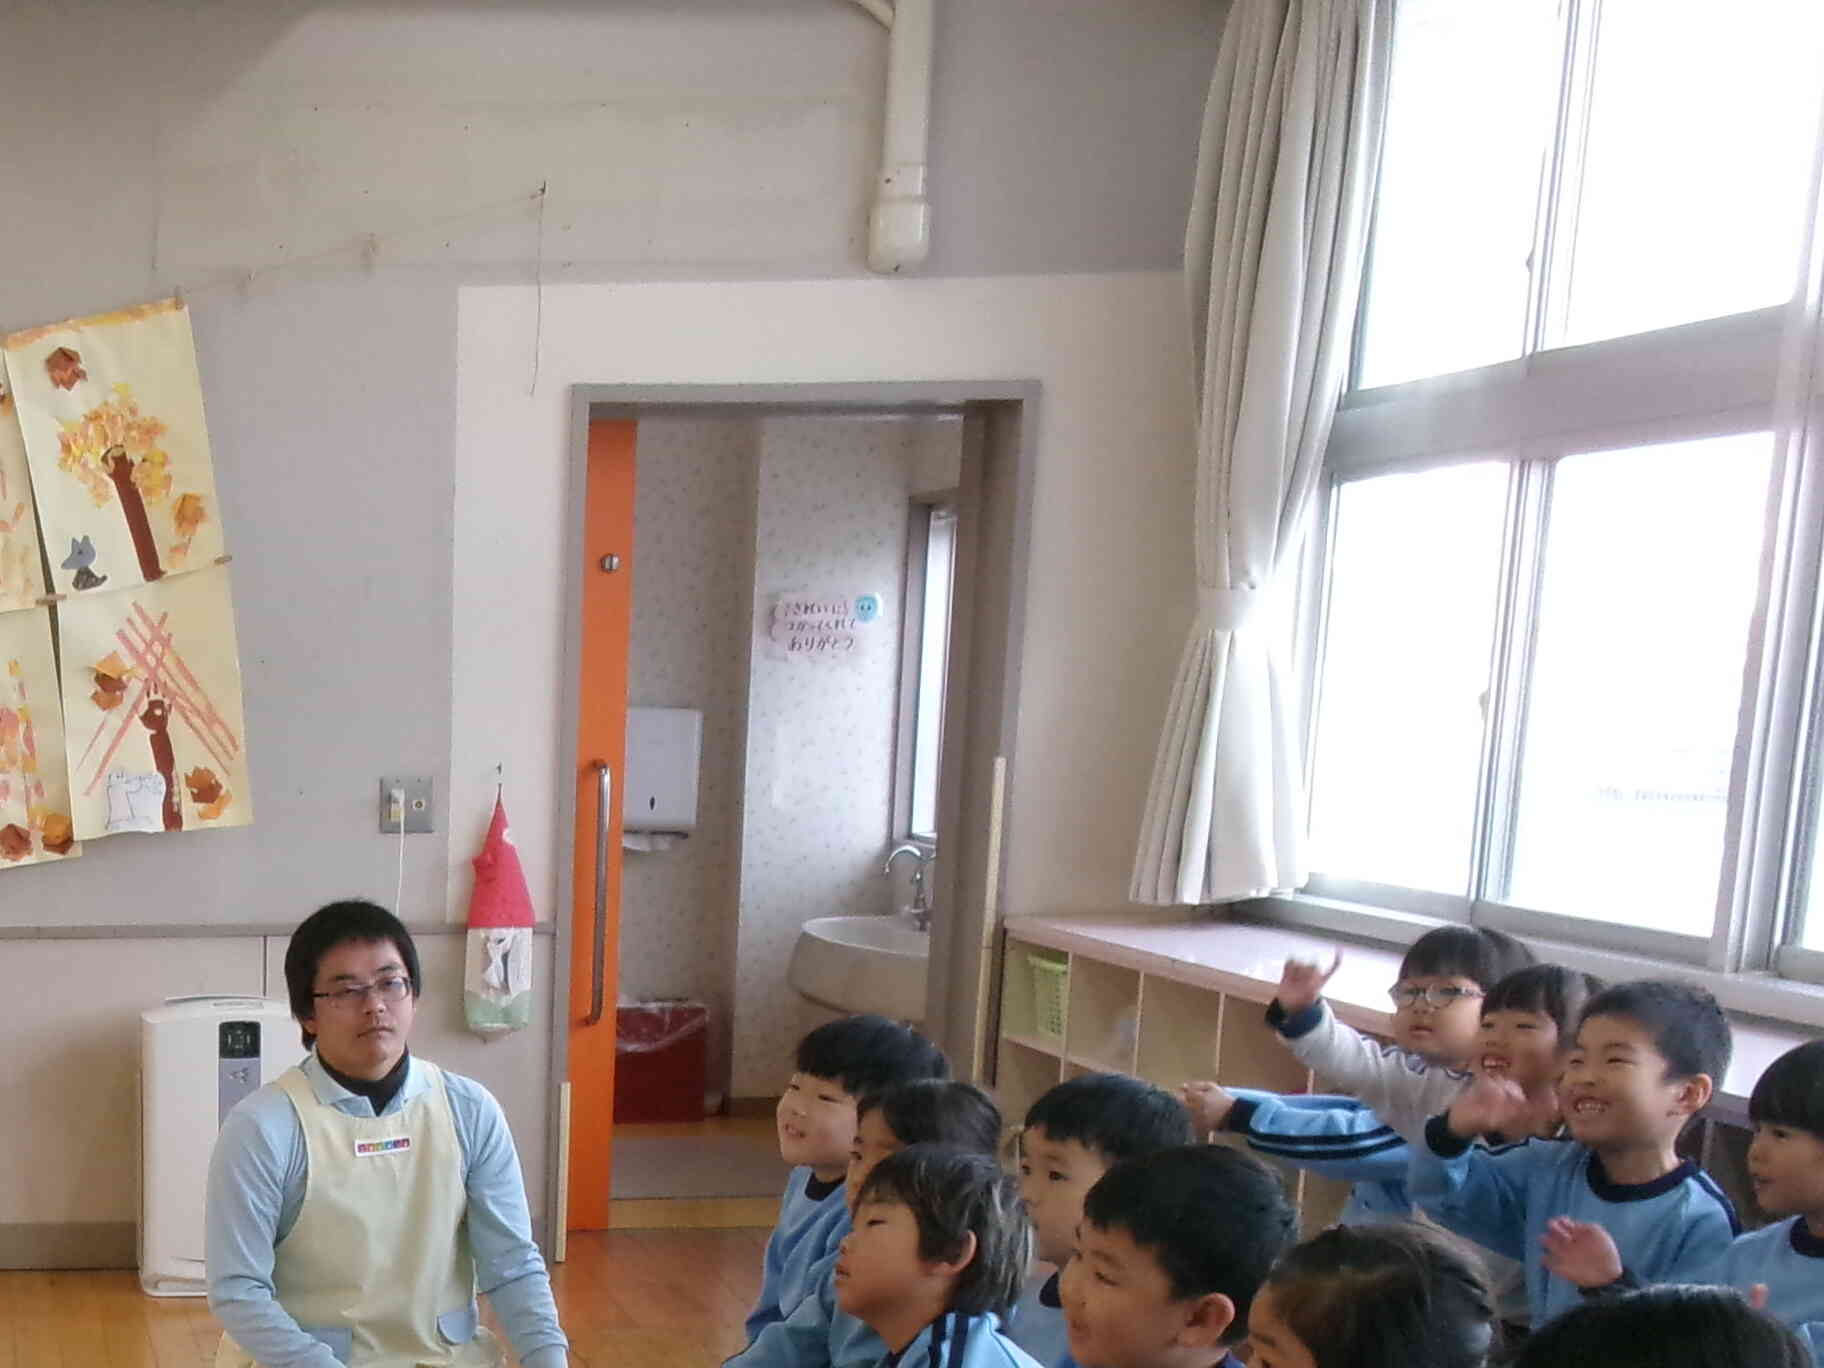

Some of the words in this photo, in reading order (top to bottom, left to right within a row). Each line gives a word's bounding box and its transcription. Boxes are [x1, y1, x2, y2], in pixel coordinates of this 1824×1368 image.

[789, 636, 854, 652] ありがとう
